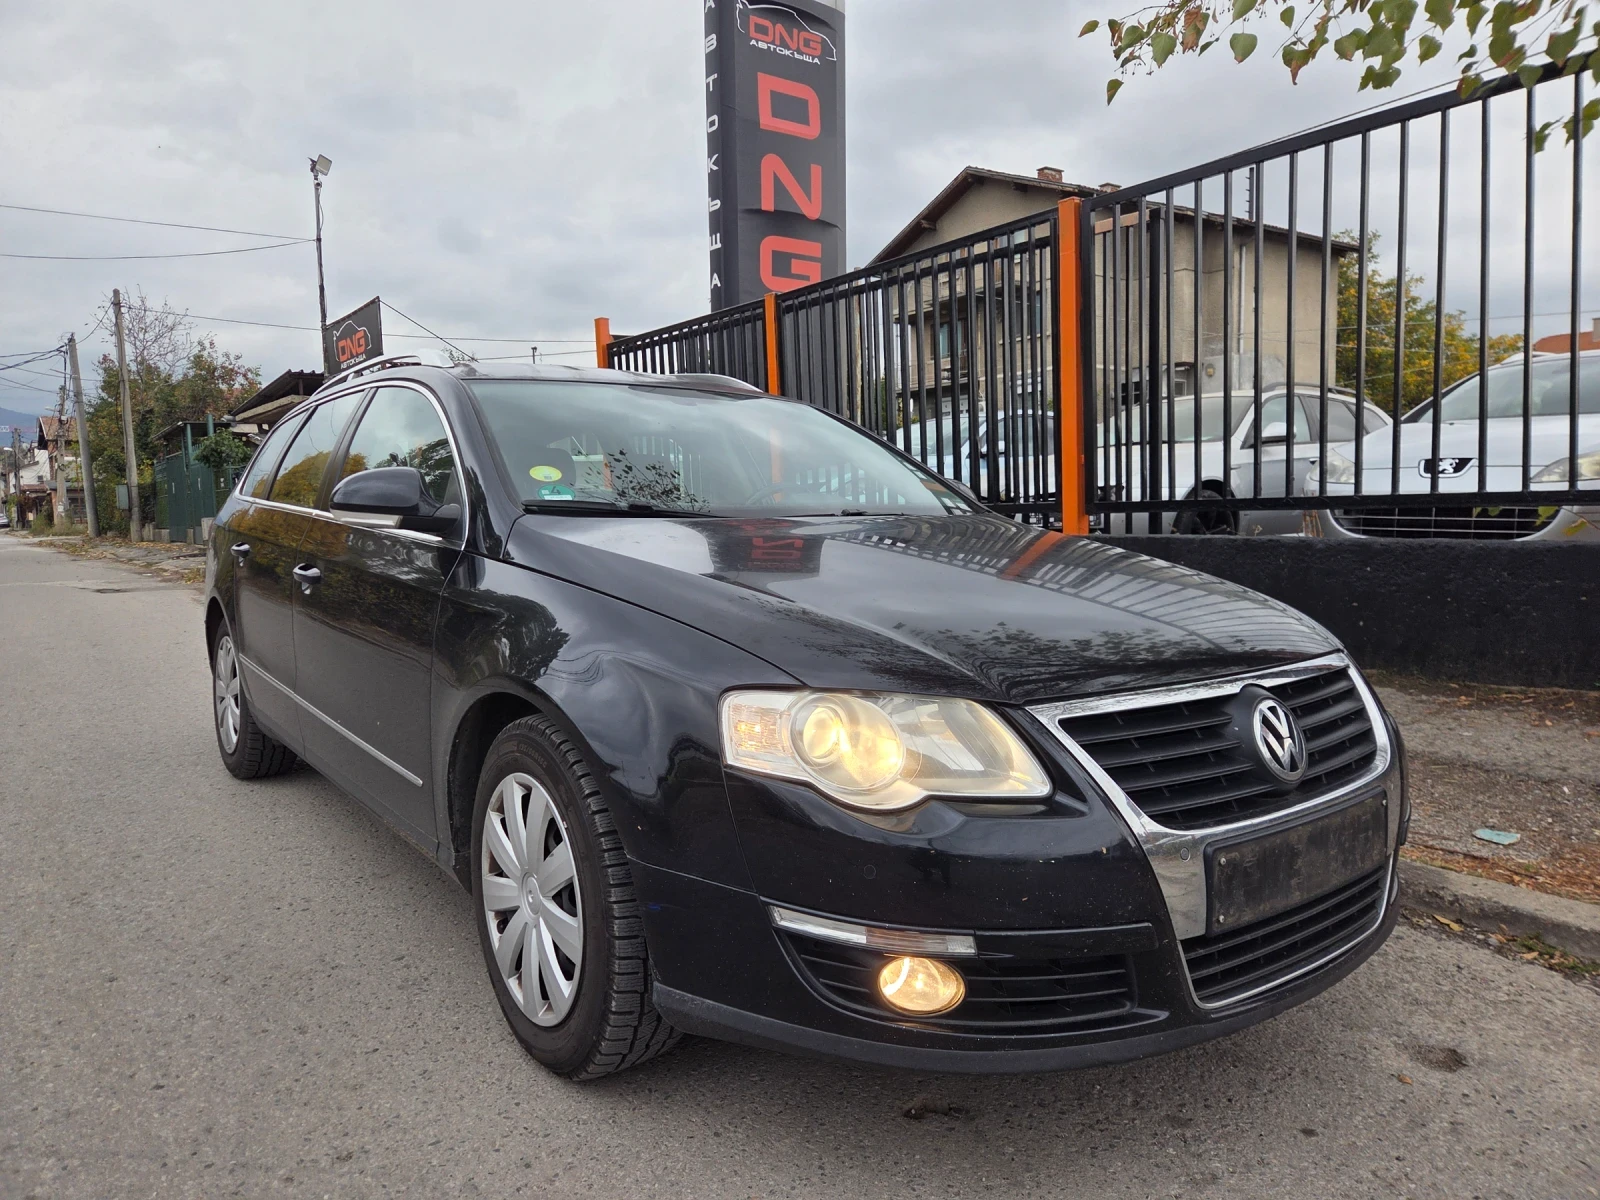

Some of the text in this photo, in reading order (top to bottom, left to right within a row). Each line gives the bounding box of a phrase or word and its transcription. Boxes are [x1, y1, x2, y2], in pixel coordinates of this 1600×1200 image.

[749, 15, 822, 56] DNG
[750, 40, 821, 65] АВТОКЪША
[757, 72, 822, 291] DNG
[338, 330, 365, 362] DNG
